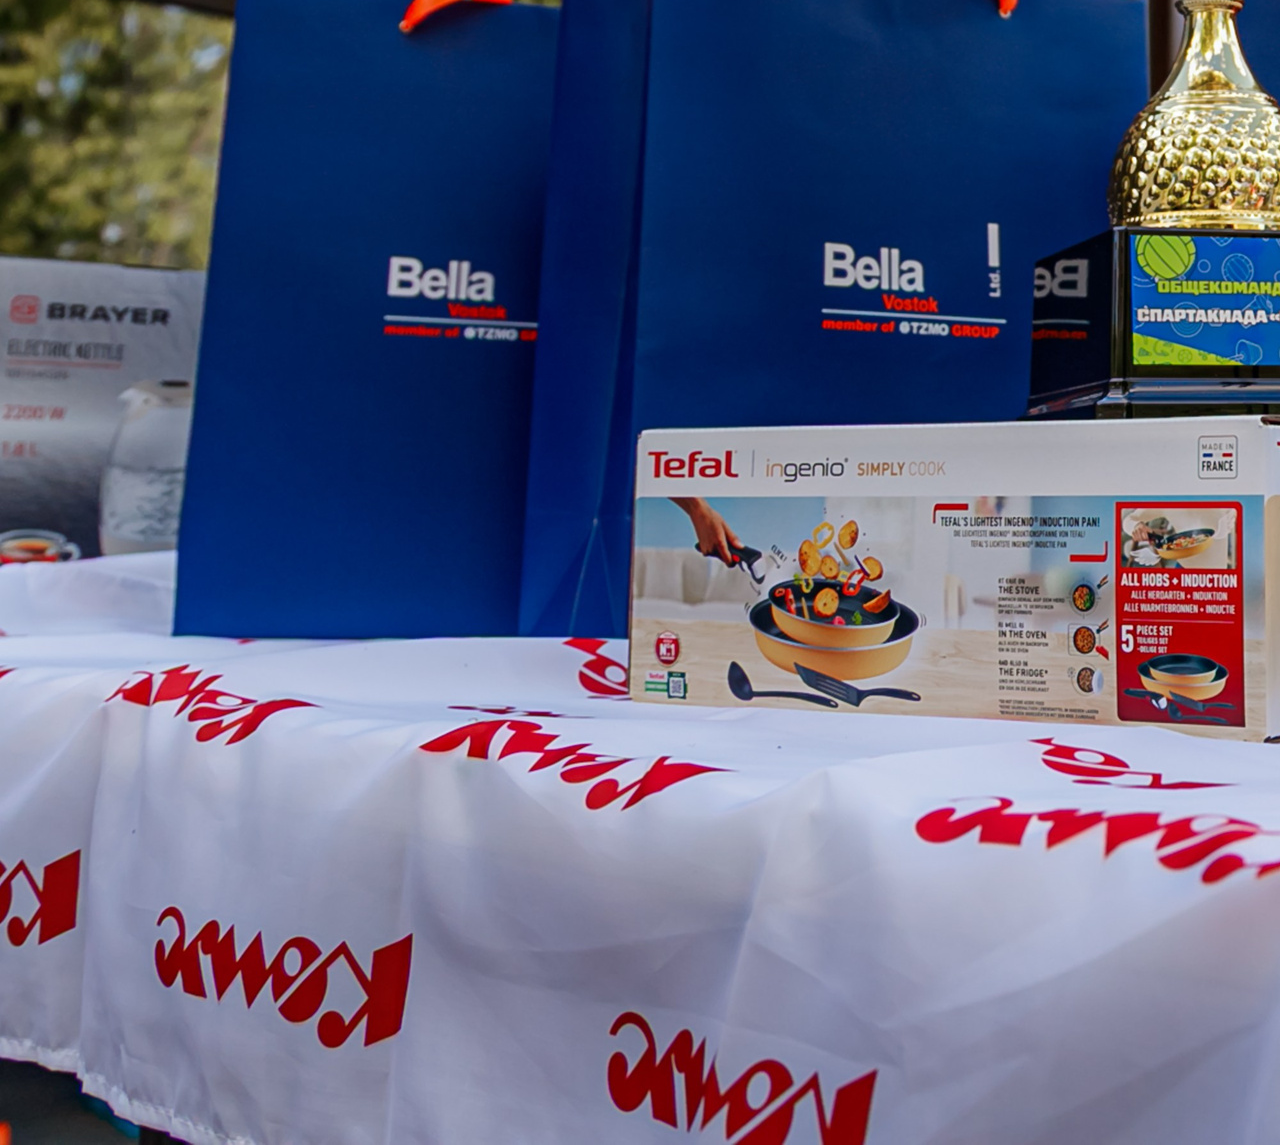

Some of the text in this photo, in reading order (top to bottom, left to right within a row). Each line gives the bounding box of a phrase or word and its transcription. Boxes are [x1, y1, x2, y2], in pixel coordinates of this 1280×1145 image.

[824, 242, 925, 292] Bella
[387, 256, 495, 301] Bella
[882, 293, 938, 313] Vostok
[47, 302, 171, 326] BRAYER
[1136, 307, 1268, 325] СПАРТАКИАДА
[821, 319, 878, 332] member
[880, 321, 895, 332] of
[951, 324, 1000, 338] GROUP
[648, 450, 739, 478] Tefal
[857, 462, 905, 477] SIMPLY
[908, 461, 946, 476] COOK
[1202, 461, 1234, 471] FRANCE
[940, 516, 968, 527] TEFAL'S
[970, 516, 1002, 527] LIGHTEST
[1039, 516, 1080, 527] INDUCTION
[1081, 517, 1100, 527] PAN!
[998, 586, 1040, 594] THE STOVE
[1121, 573, 1140, 586] ALL
[1142, 574, 1170, 586] HOBS
[1181, 574, 1238, 588] INDUCTION
[998, 630, 1007, 638] IN
[1025, 631, 1047, 639] OVEN
[1121, 625, 1173, 653] 5 PIECE SET
[999, 668, 1014, 676] THE
[155, 906, 413, 1049] Комус
